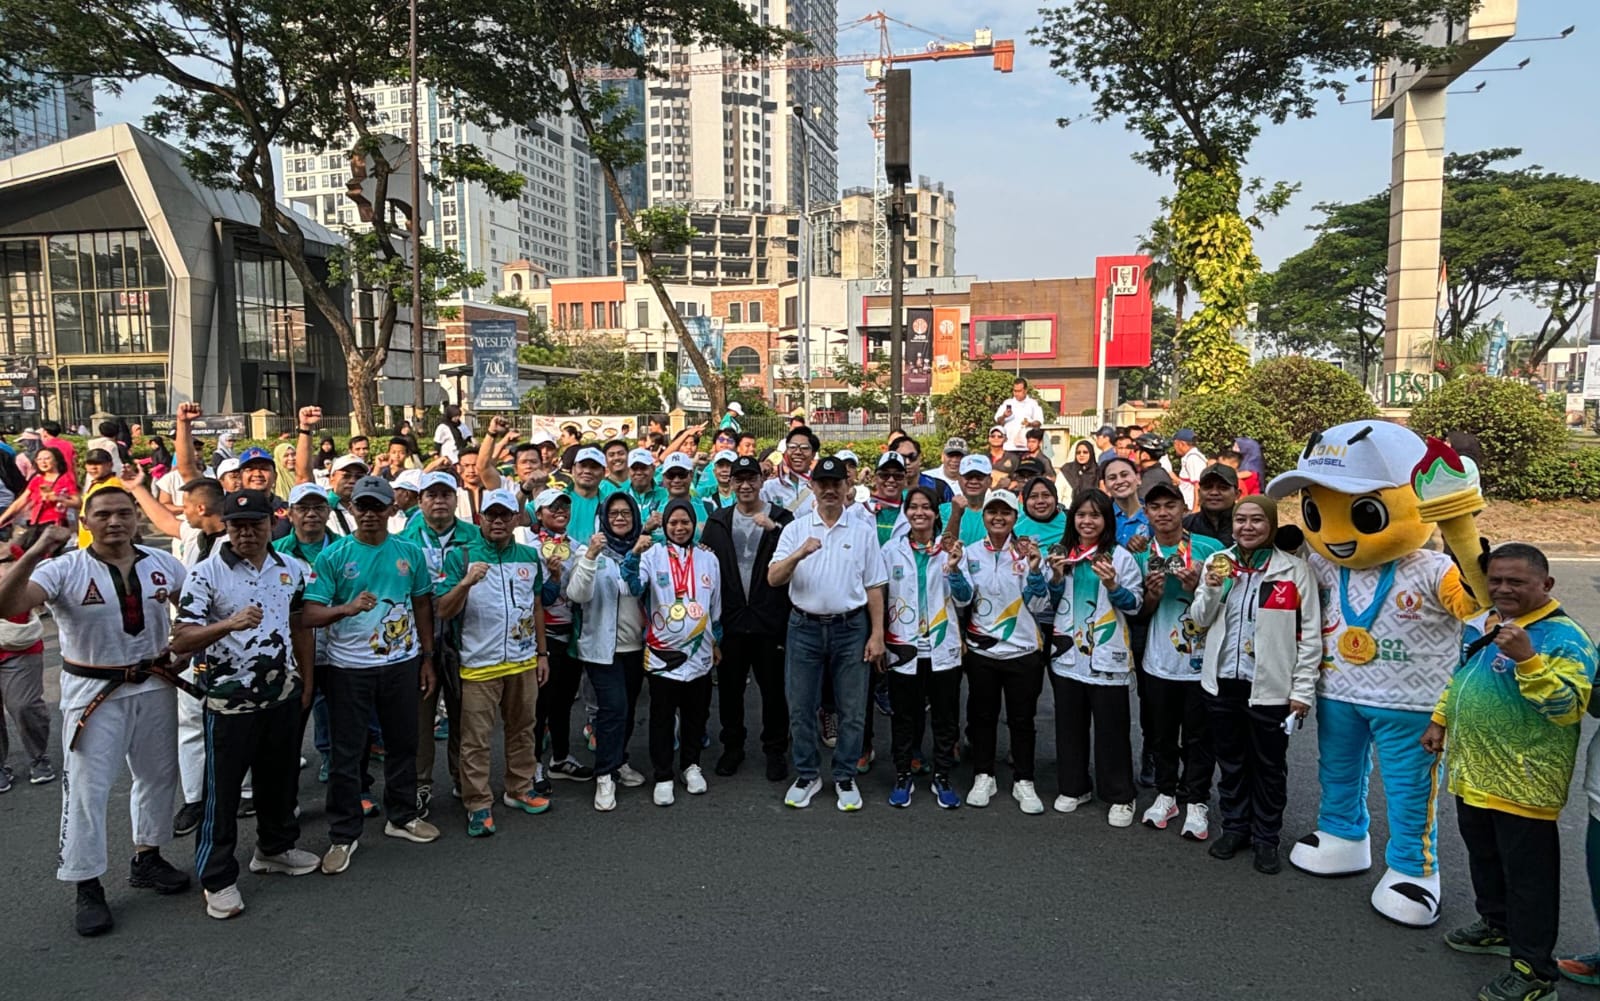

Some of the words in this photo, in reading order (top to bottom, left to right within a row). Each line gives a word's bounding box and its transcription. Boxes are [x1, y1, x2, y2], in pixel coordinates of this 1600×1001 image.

[874, 280, 911, 292] KC
[474, 336, 514, 348] WESLEY
[484, 361, 504, 375] 700
[1385, 372, 1446, 403] BSD
